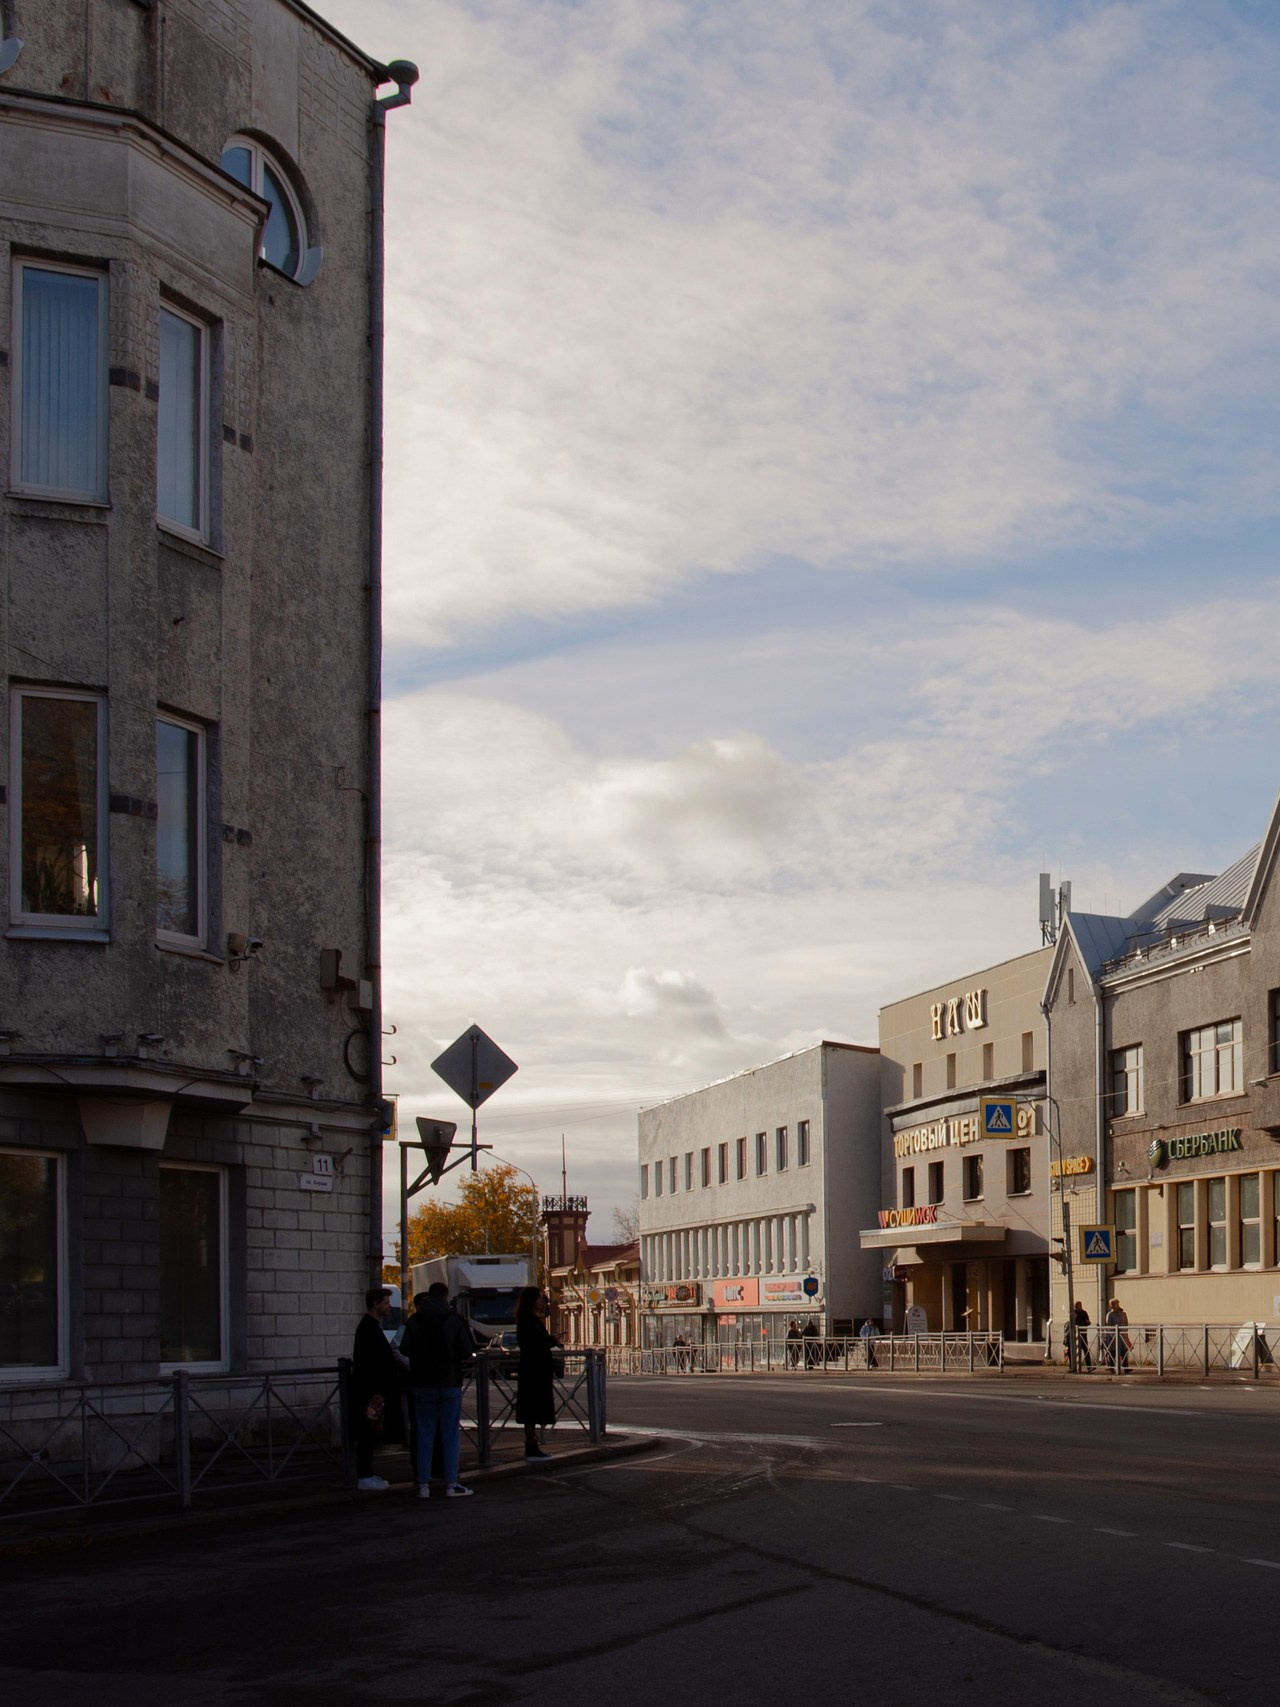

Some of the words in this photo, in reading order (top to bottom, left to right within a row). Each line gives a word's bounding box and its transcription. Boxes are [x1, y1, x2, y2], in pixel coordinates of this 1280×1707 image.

[931, 988, 986, 1040] НАШ
[894, 1118, 946, 1158] ТОРГОВЫЙ
[950, 1117, 979, 1148] ЦЕН
[1167, 1128, 1239, 1160] СБЕРБАНК
[317, 1158, 328, 1171] 11
